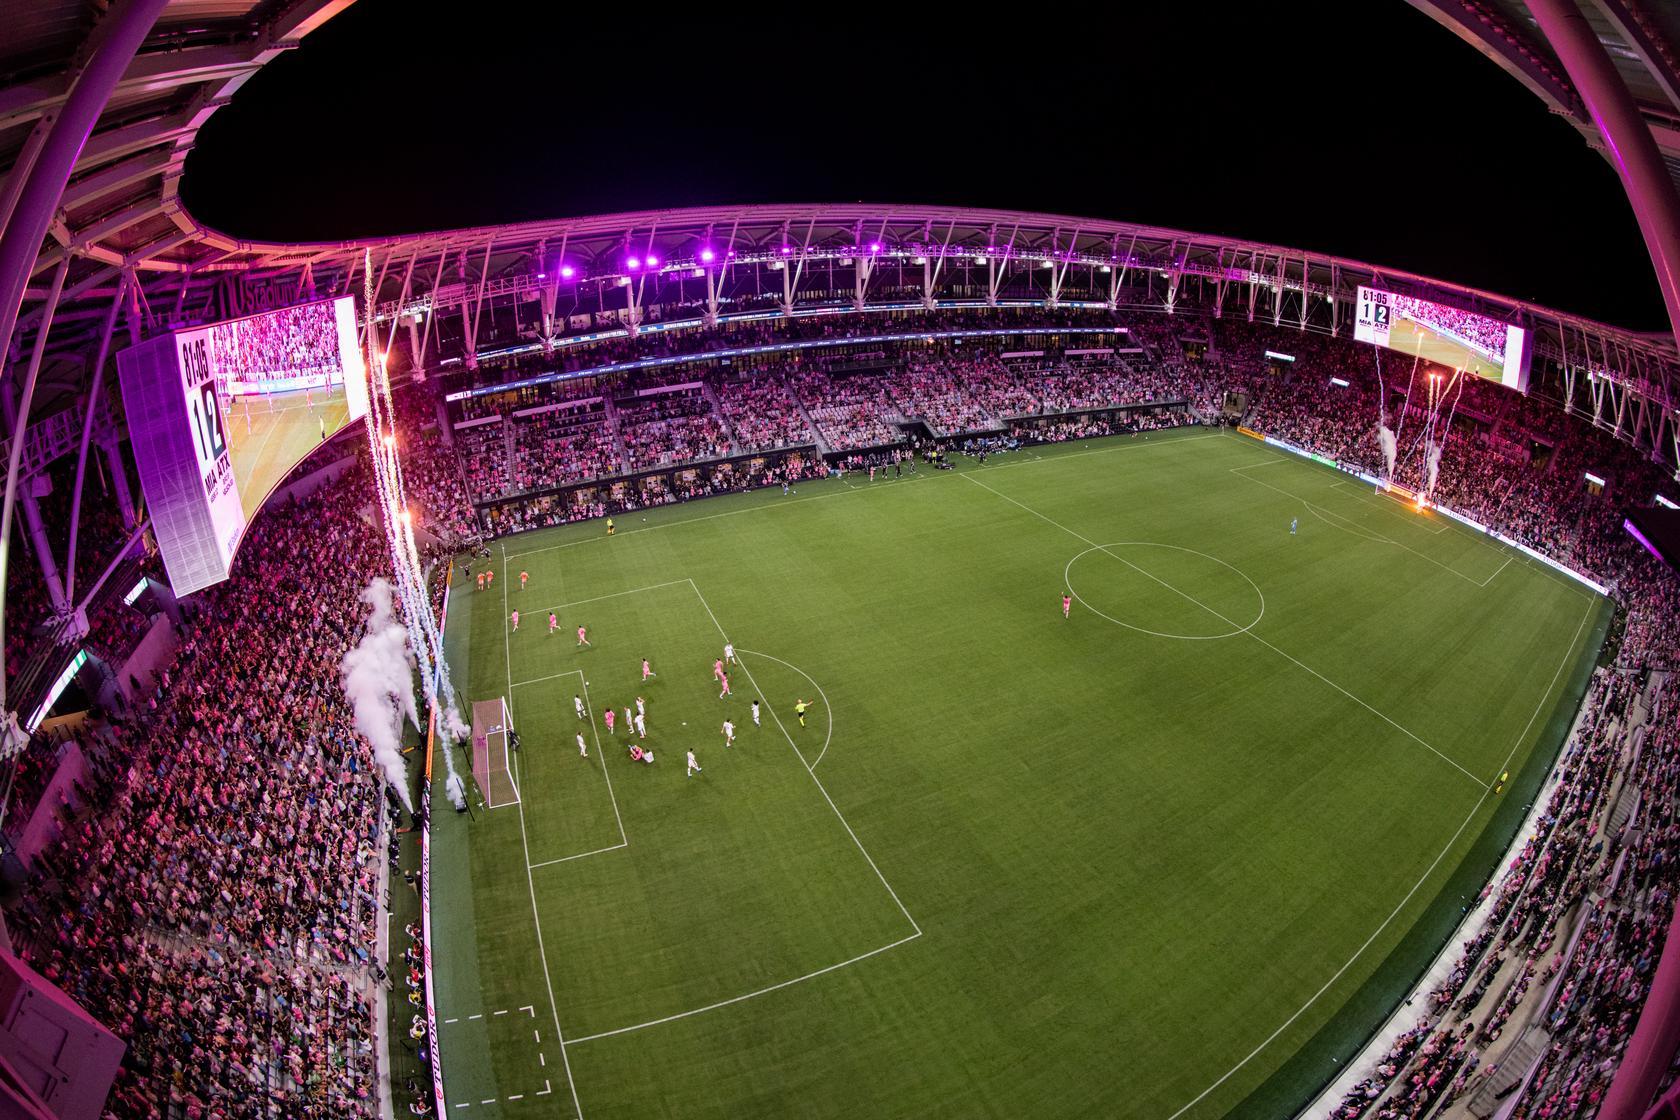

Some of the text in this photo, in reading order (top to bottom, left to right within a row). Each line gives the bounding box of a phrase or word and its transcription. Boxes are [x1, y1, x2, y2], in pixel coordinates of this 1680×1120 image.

[1363, 290, 1387, 304] 81:05
[1364, 303, 1387, 323] 1 2
[183, 339, 209, 388] 81:05
[194, 389, 222, 460] 1 2
[205, 469, 218, 496] MIA
[217, 452, 231, 479] ATX
[430, 1019, 441, 1085] TUDOR
